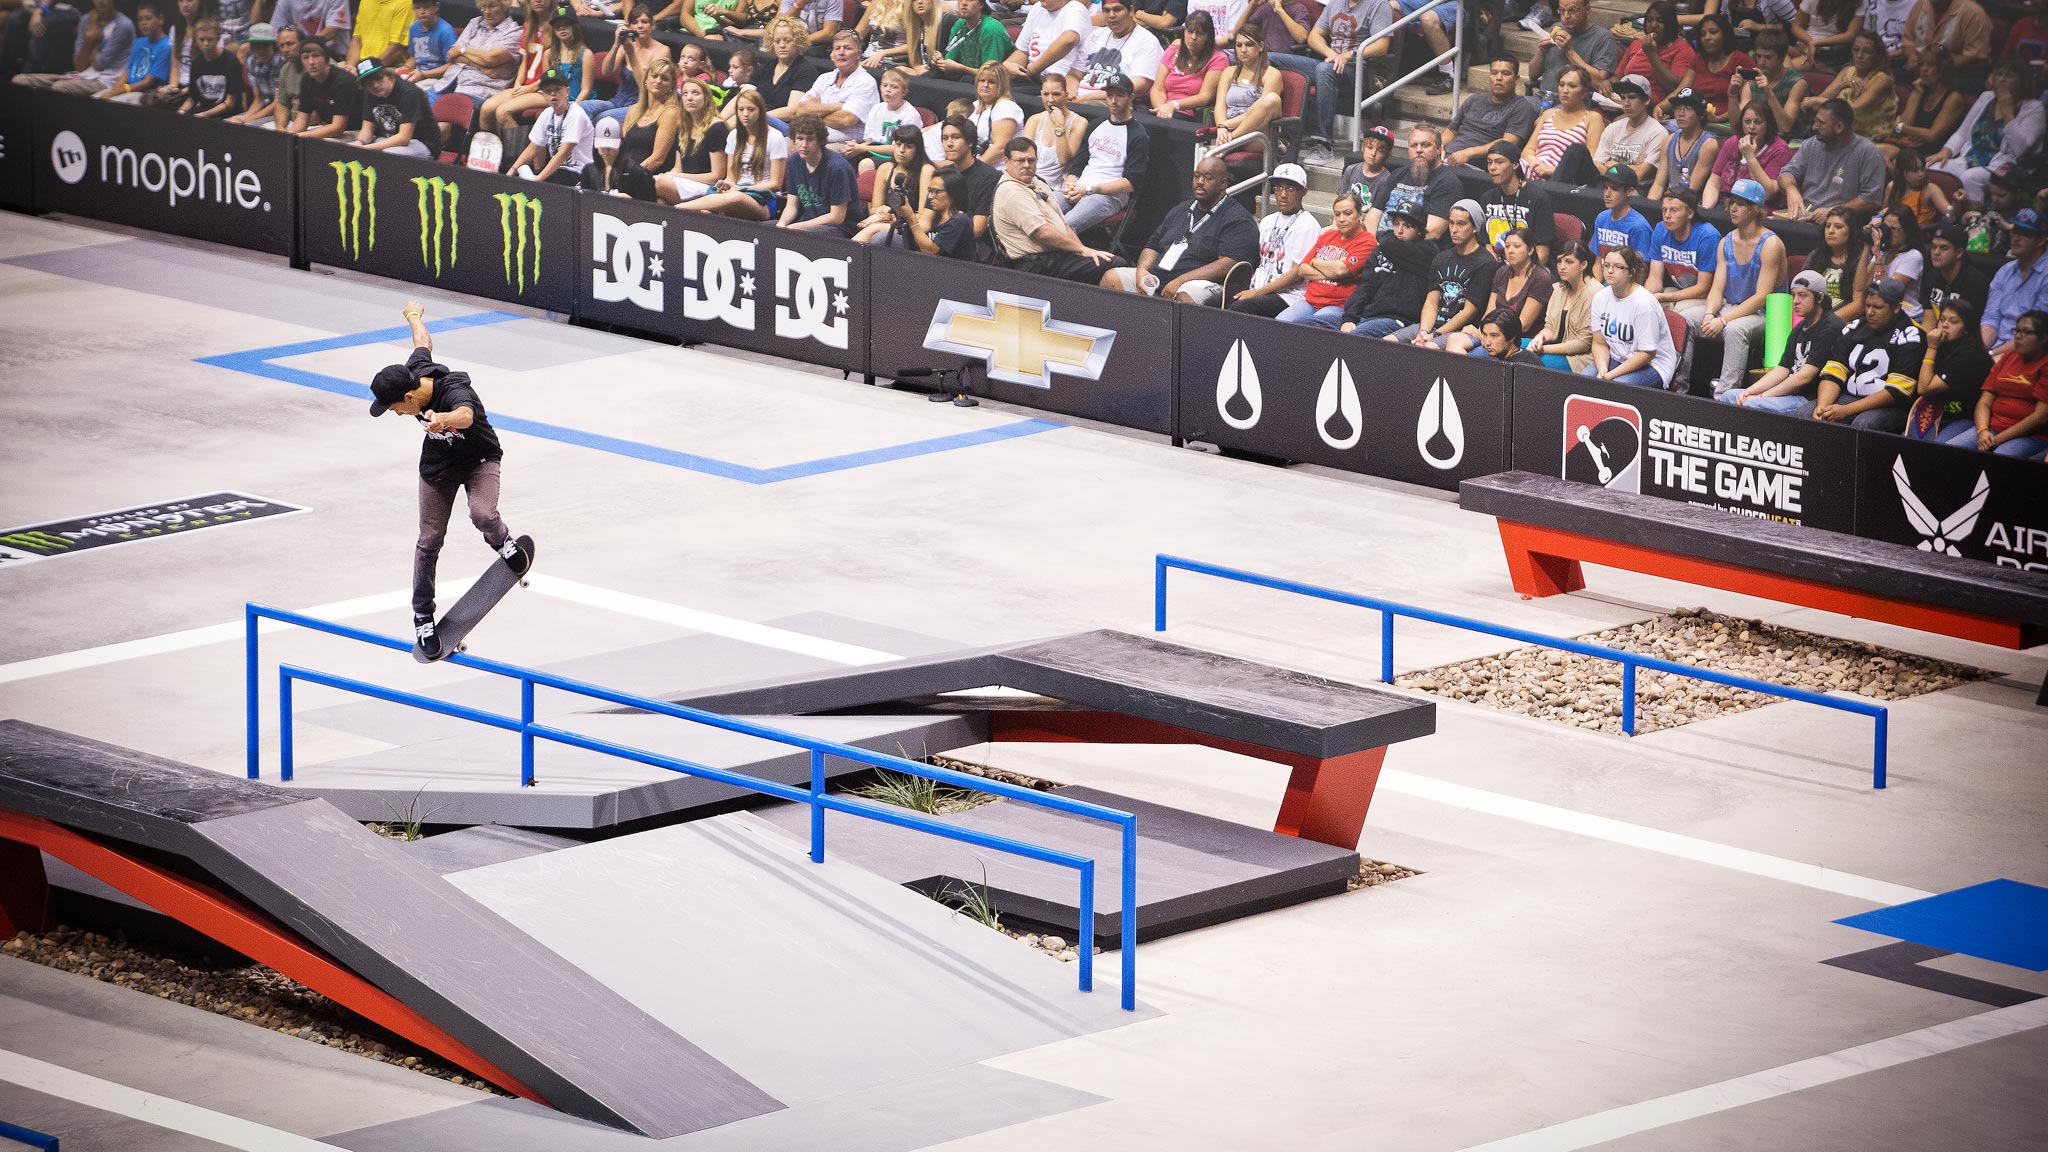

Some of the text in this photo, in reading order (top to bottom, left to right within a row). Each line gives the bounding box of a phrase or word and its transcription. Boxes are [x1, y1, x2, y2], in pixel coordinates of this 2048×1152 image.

[1597, 227, 1630, 246] STREET
[593, 212, 848, 349] DC DC DC
[1648, 418, 1804, 469] STREET LEAGUE
[1648, 448, 1709, 495] THE
[1714, 461, 1803, 514] GAME
[60, 499, 269, 540] MONSTER
[1984, 522, 2048, 557] AIR
